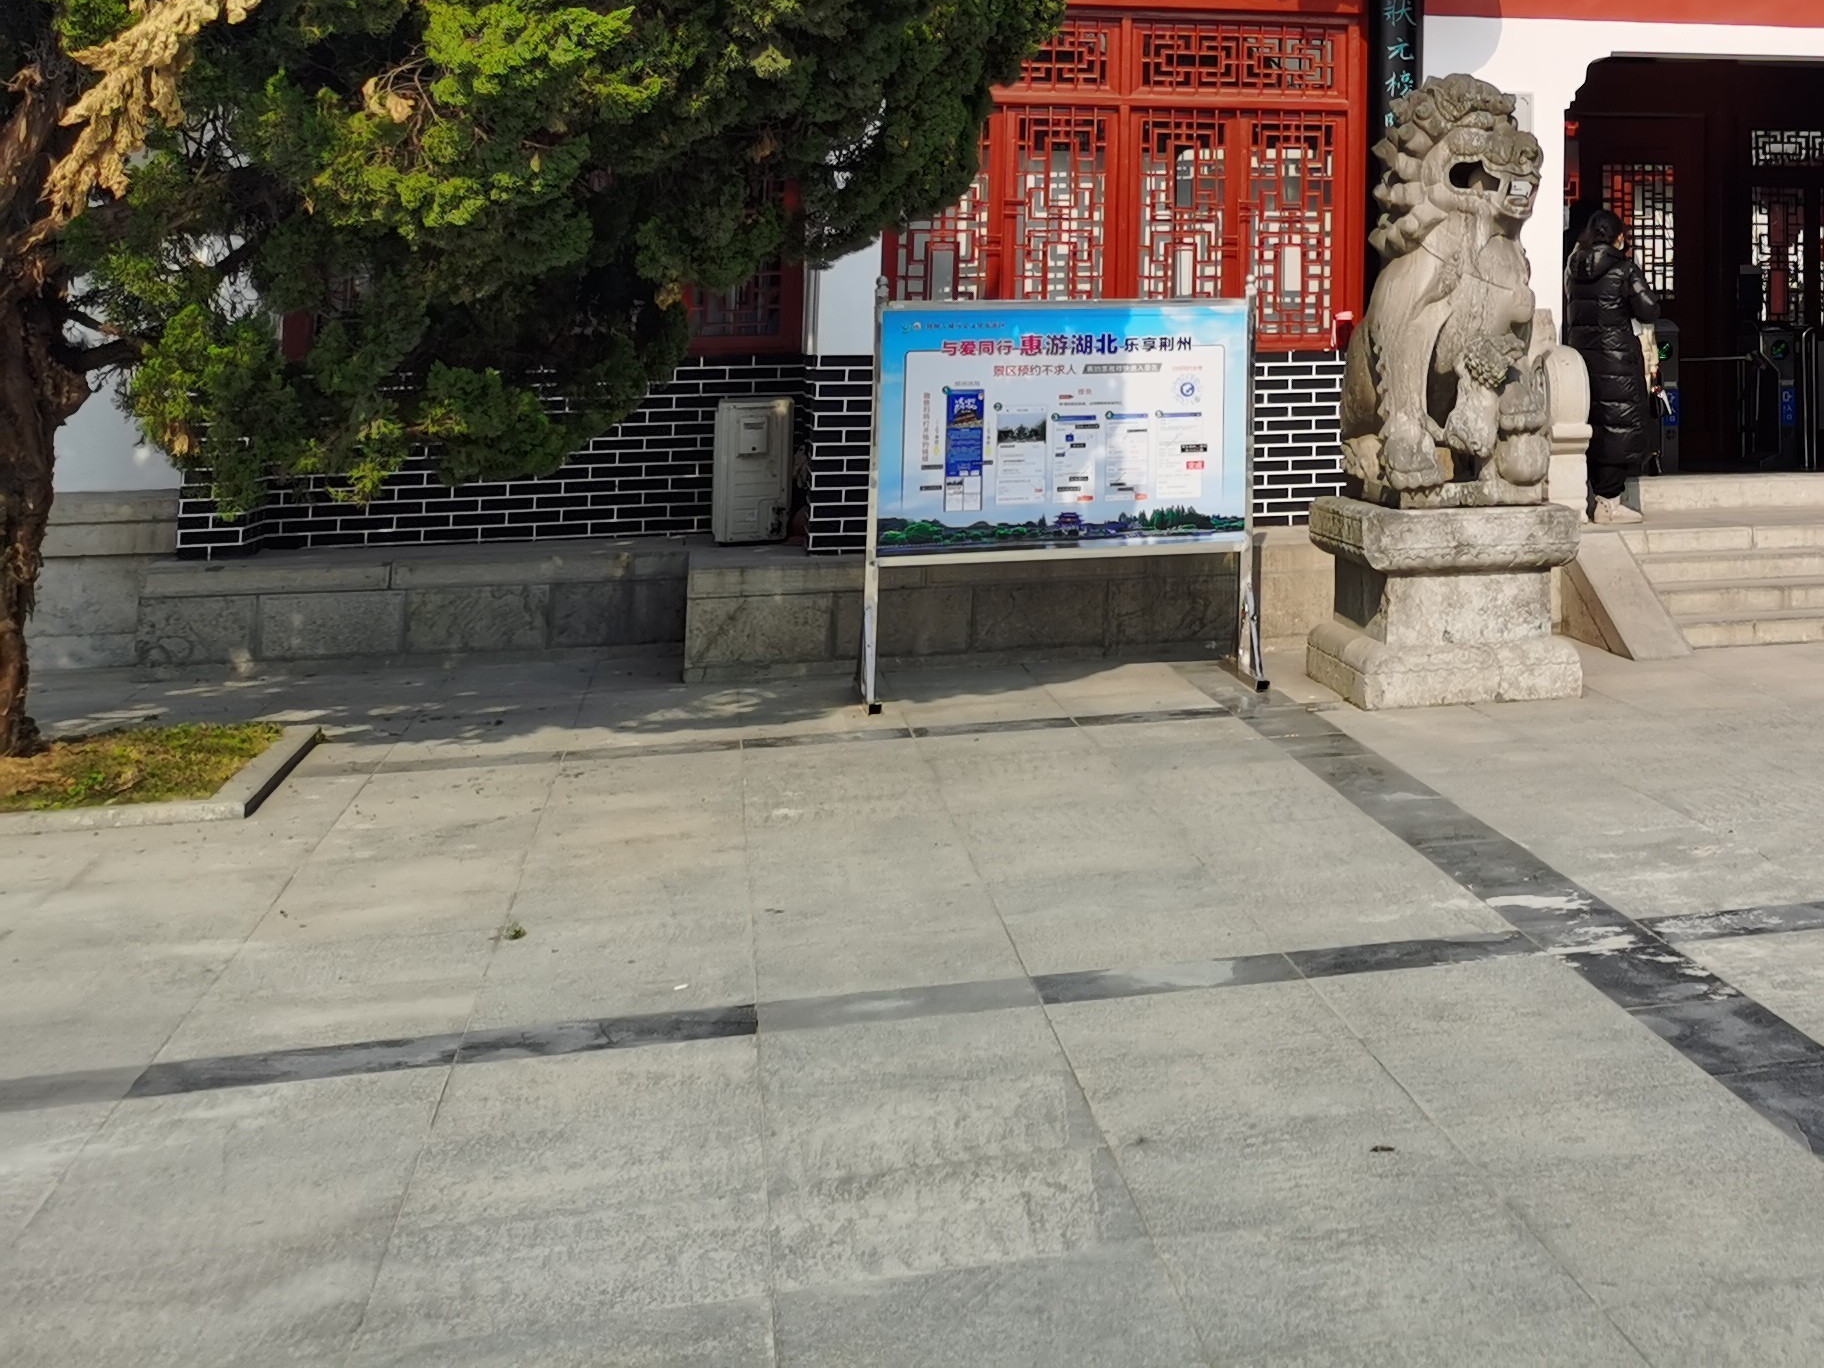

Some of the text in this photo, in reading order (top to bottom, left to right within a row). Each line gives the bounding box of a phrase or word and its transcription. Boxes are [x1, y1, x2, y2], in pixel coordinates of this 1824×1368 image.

[942, 333, 1192, 357] 与爱同行 惠游湖北 乐享荆州
[993, 363, 1078, 377] 景区预约不求人
